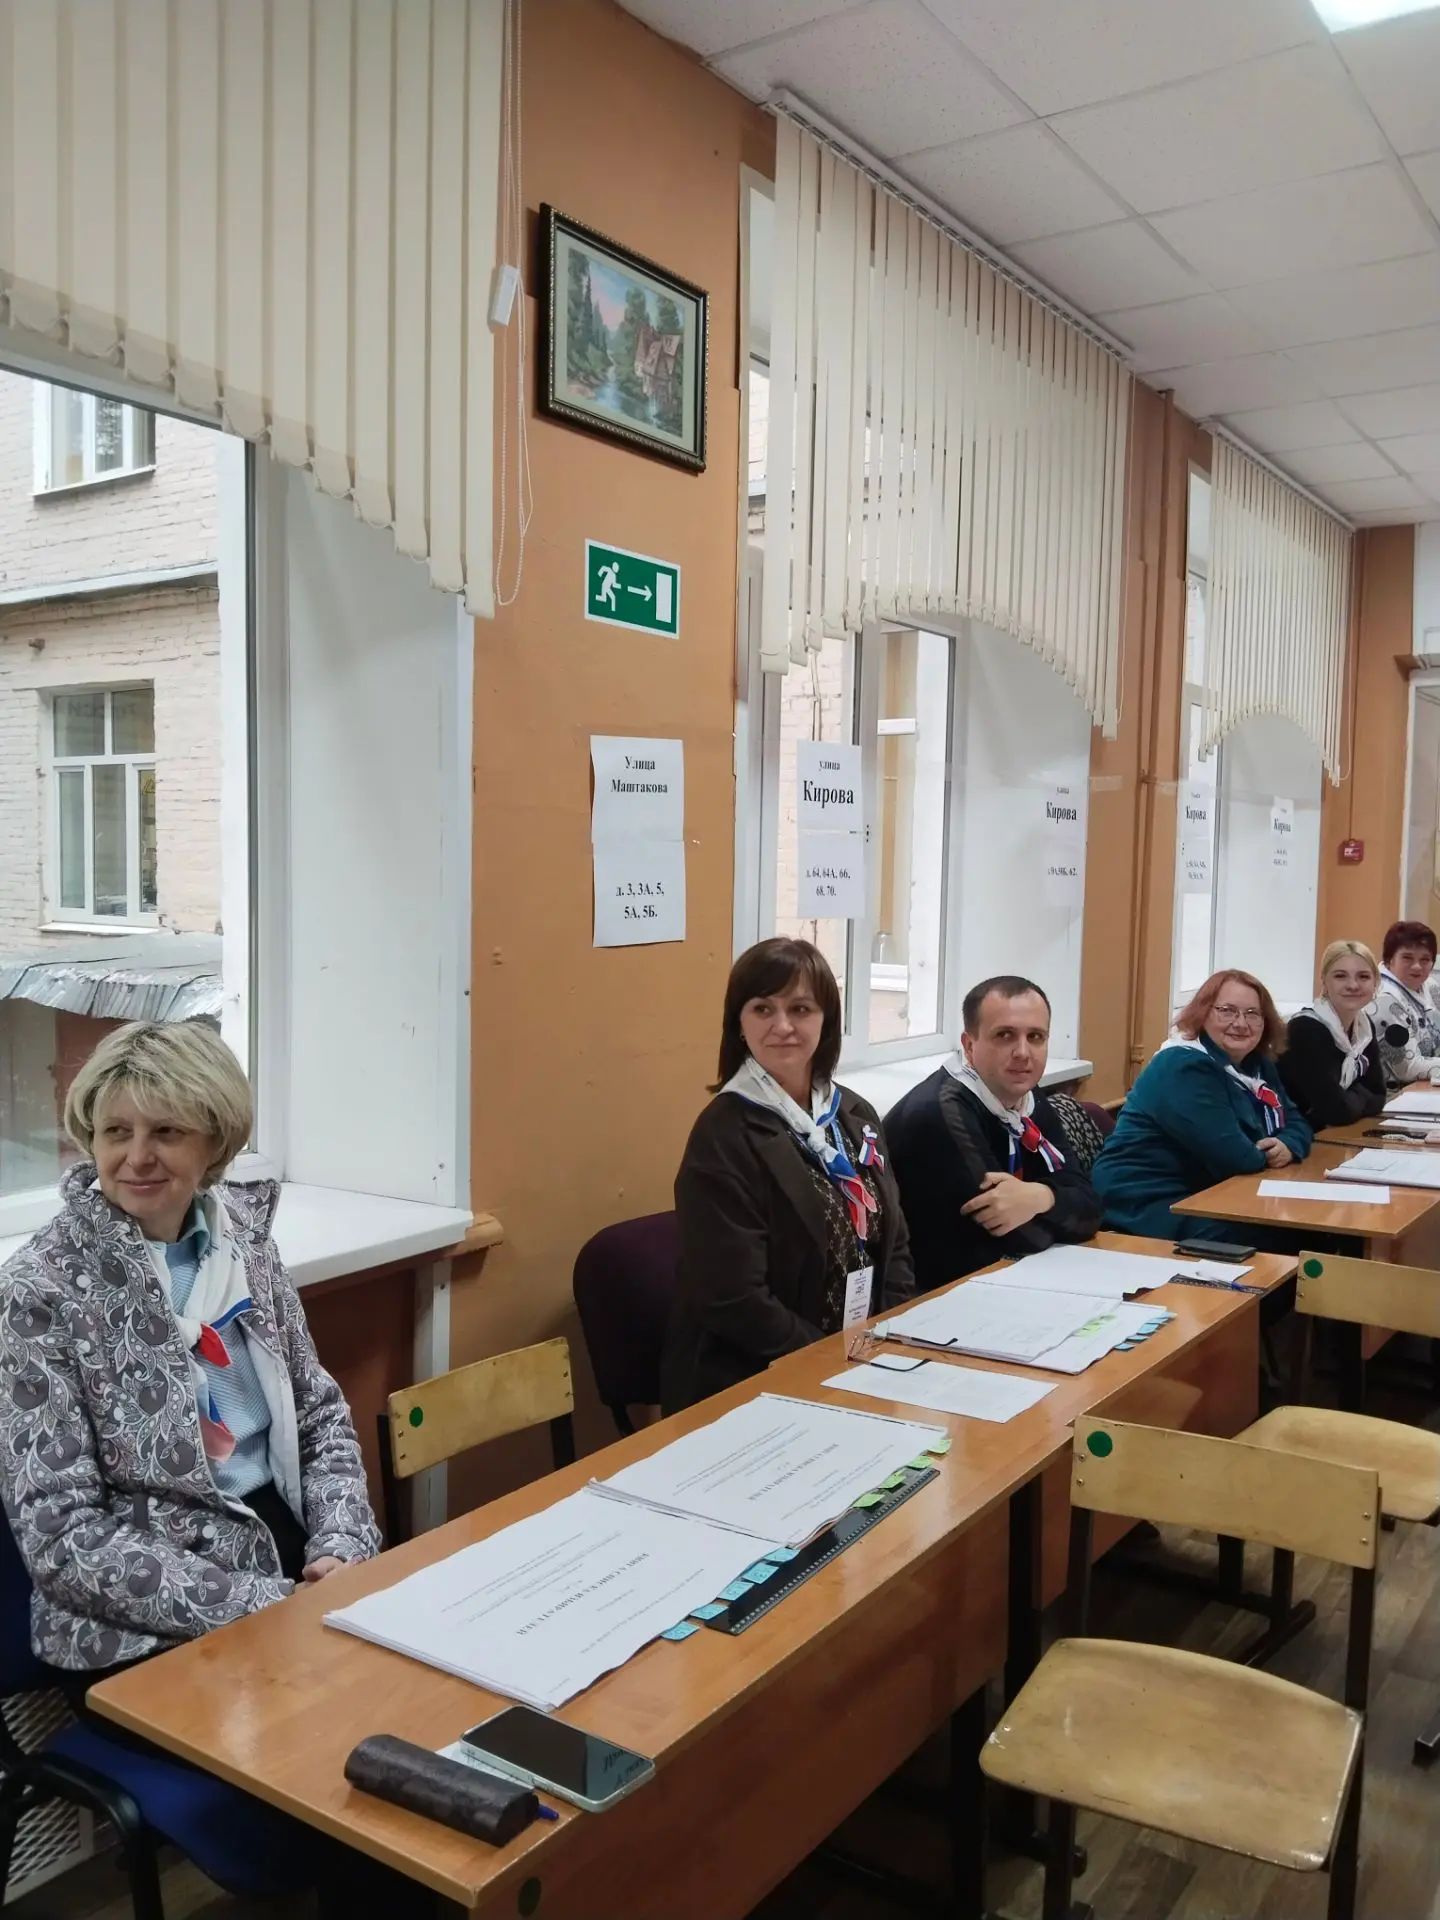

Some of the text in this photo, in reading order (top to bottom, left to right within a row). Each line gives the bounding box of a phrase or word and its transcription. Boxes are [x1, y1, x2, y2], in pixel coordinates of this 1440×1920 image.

[624, 755, 656, 771] Улица
[818, 759, 841, 772] улица
[610, 778, 669, 794] Маштакова
[803, 779, 855, 809] Кирова
[1046, 801, 1077, 823] Кирова
[1185, 804, 1207, 824] Кирова
[627, 882, 636, 898] 3,
[656, 881, 665, 897] 5,
[642, 904, 658, 919] 5Б.
